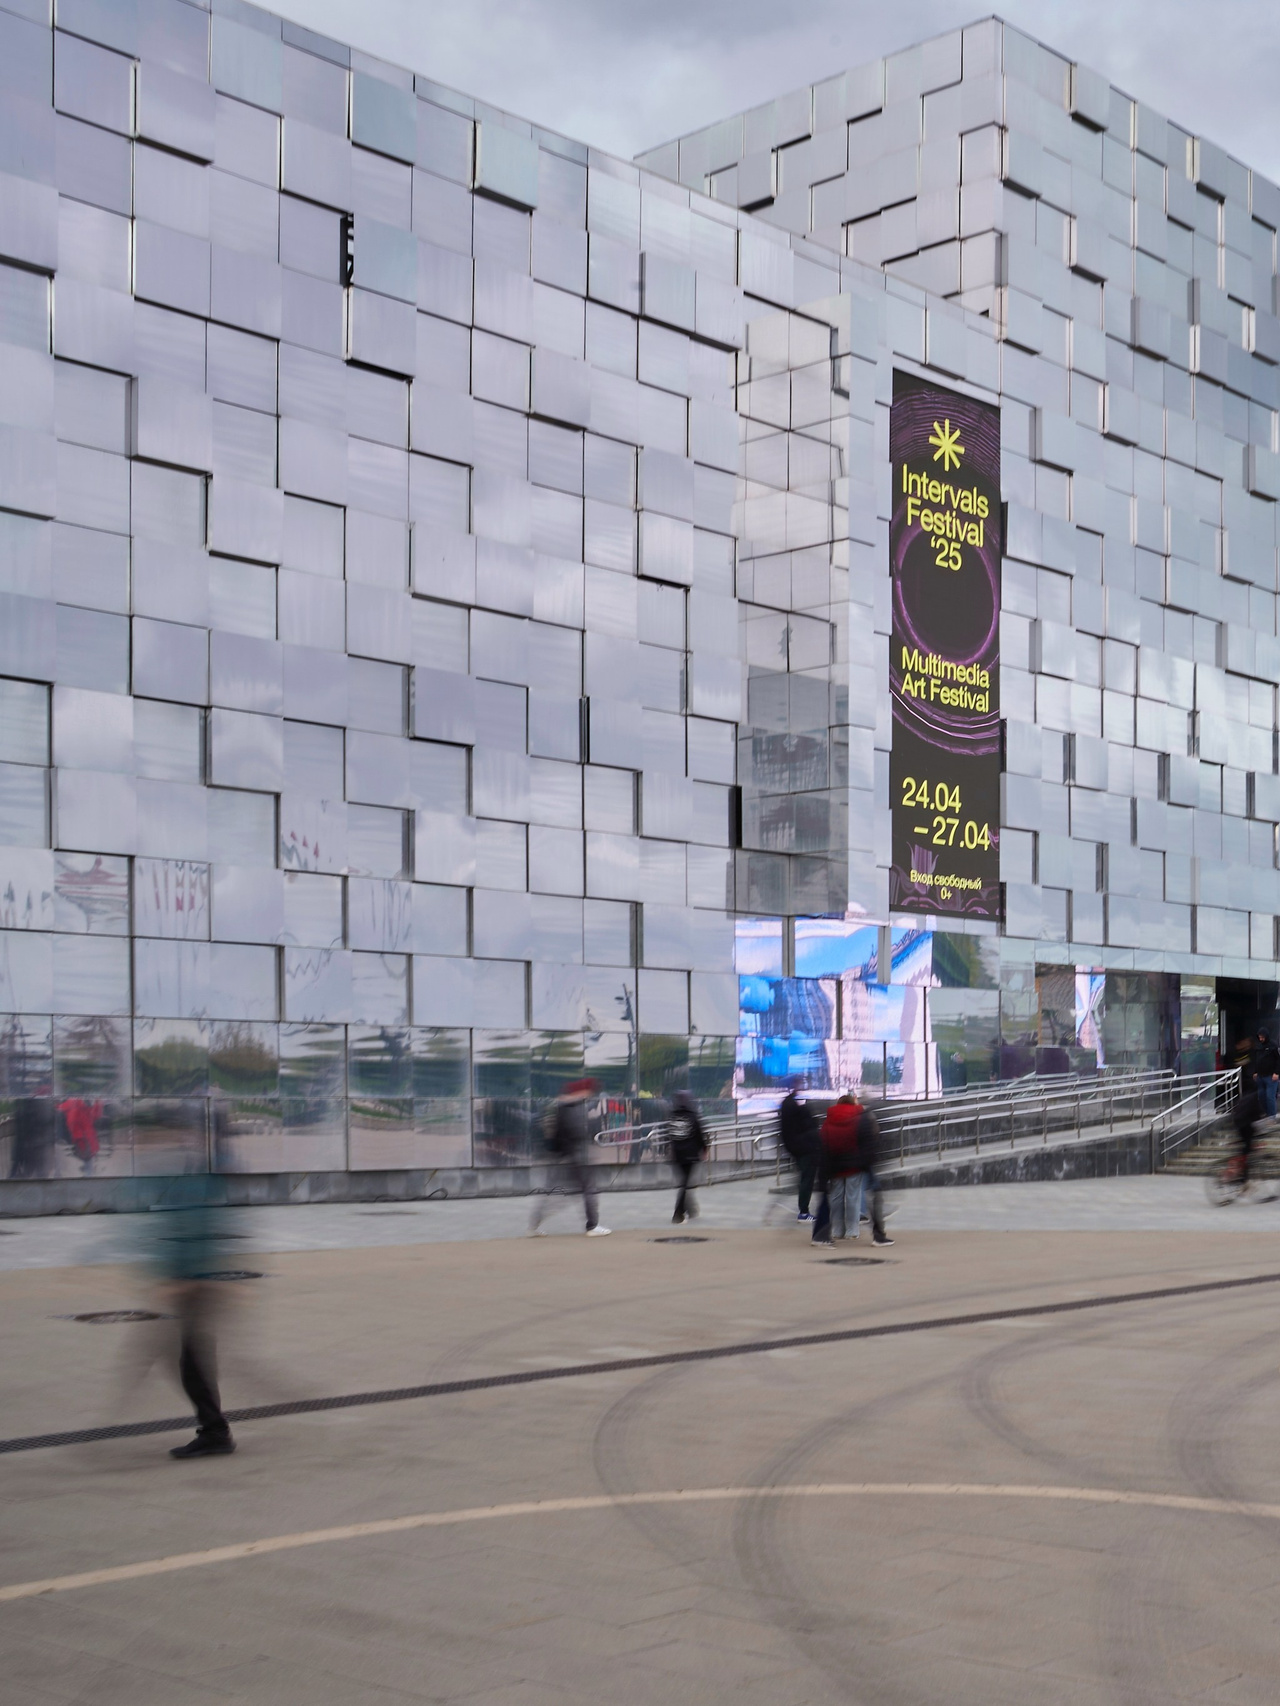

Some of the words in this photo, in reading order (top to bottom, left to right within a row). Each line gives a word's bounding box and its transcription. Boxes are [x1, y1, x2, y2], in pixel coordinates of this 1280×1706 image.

[902, 463, 989, 519] Intervals
[907, 496, 984, 548] Festival
[902, 646, 990, 688] Multimedia
[901, 673, 926, 699] Art
[930, 678, 989, 713] Festival
[902, 777, 962, 813] 24.04
[910, 869, 933, 886] Вход
[934, 873, 982, 890] свободный
[940, 887, 952, 900] 0+
